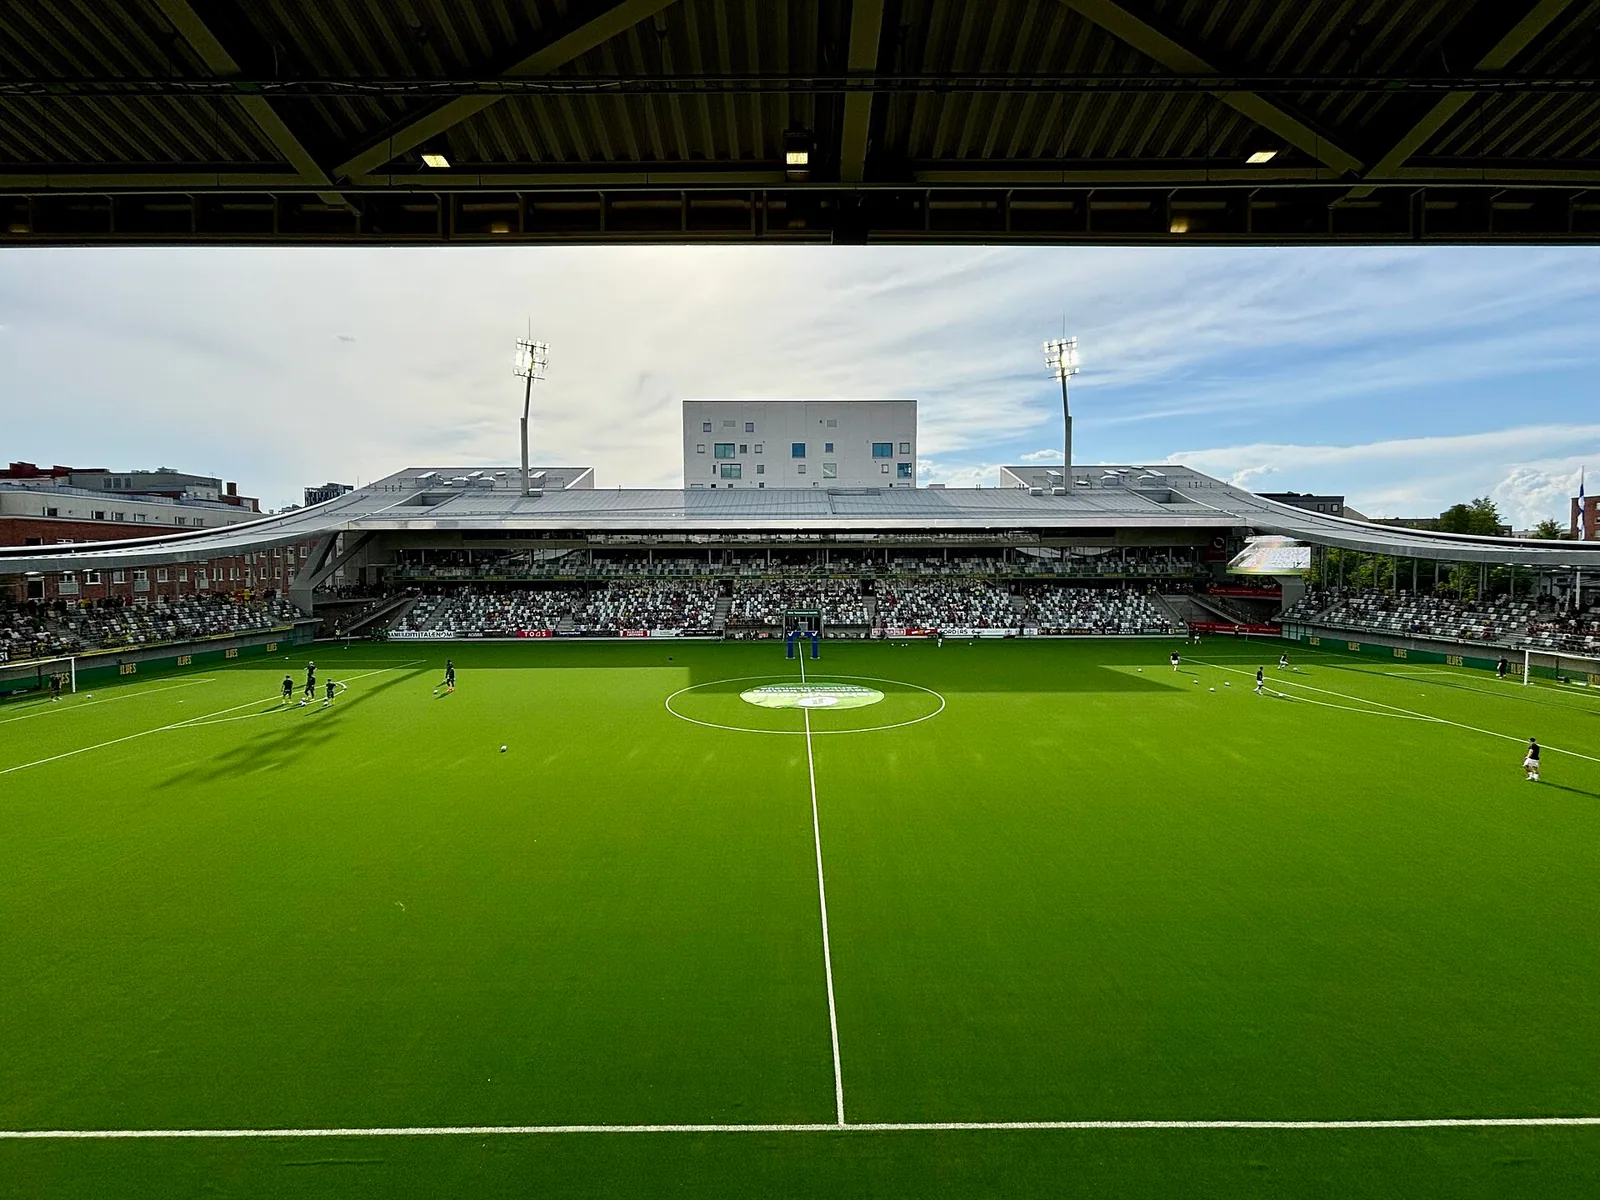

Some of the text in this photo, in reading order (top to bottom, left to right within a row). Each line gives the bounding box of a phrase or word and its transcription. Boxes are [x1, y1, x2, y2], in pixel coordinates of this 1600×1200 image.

[177, 655, 192, 667] ILVES
[1446, 654, 1464, 668] ILVES
[120, 663, 137, 675] ILVES
